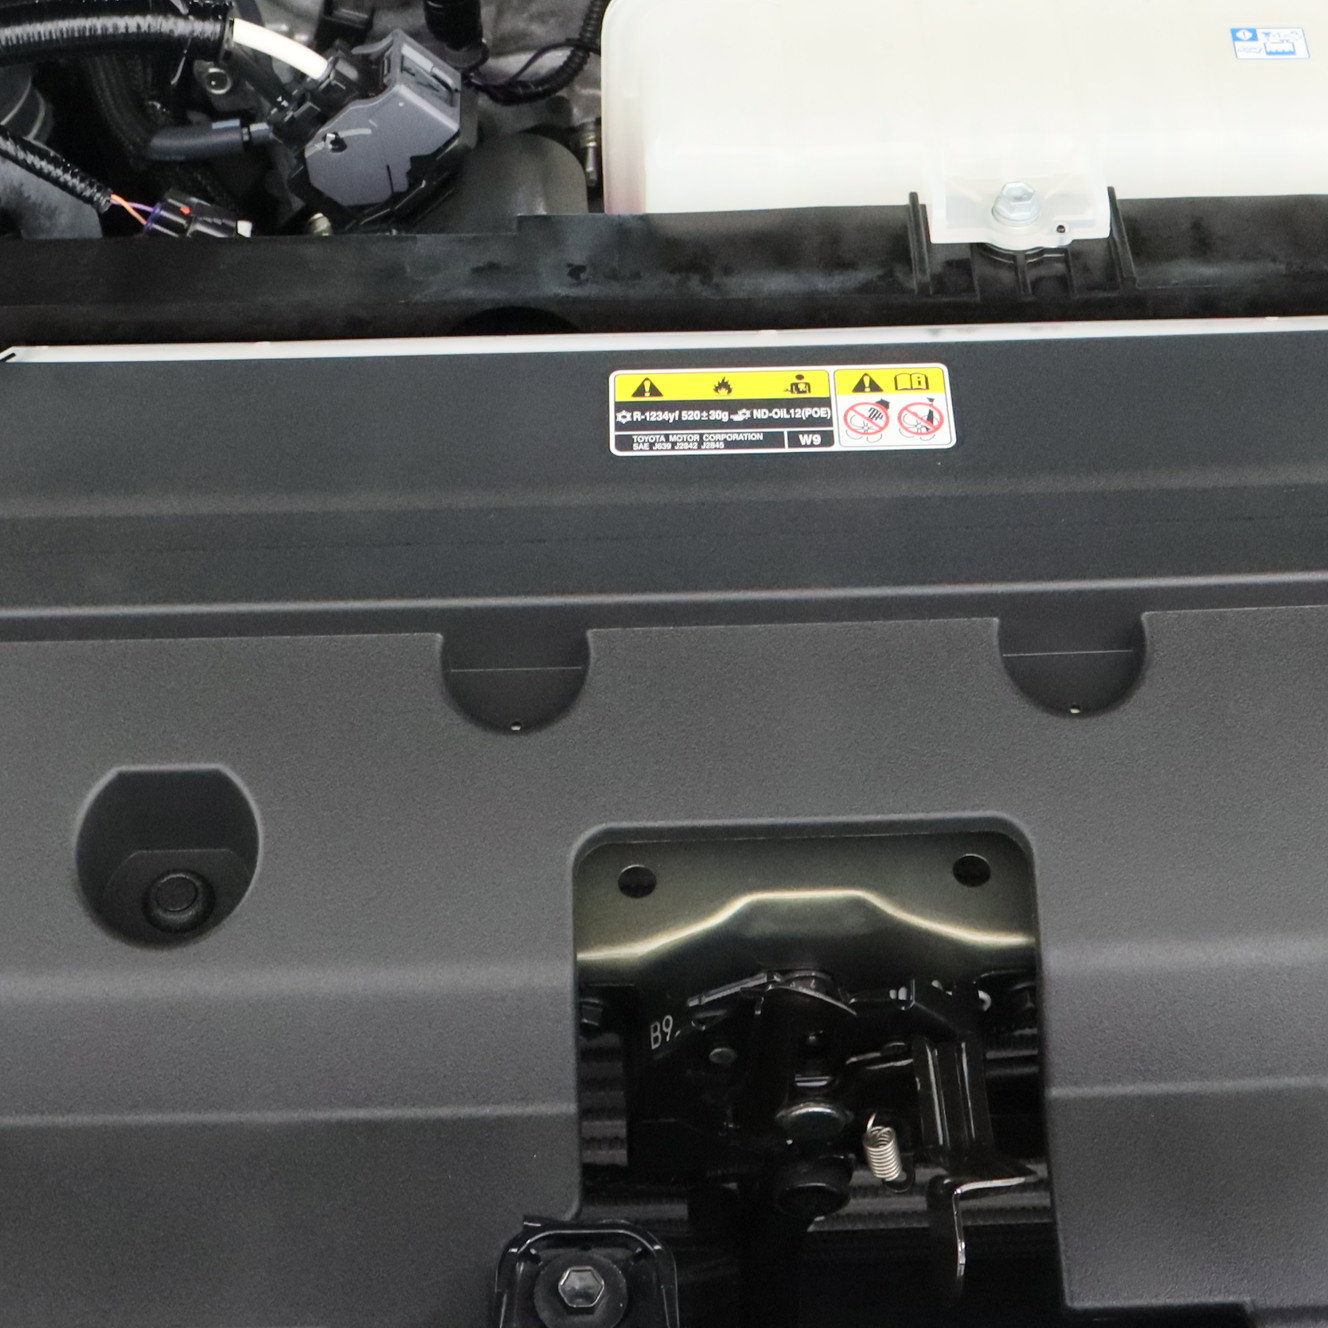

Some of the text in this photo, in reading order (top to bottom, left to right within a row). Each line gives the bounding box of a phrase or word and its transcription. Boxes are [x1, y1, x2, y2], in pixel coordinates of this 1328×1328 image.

[632, 407, 832, 423] R-1234yf 520±30g ND-OIL12(POE)
[632, 432, 763, 443] TOYOTA MOTOR CORPORATION
[798, 433, 822, 446] W9
[652, 442, 671, 450] J639
[674, 442, 698, 450] J2842
[701, 441, 725, 449] J2845
[649, 1014, 674, 1050] B9
